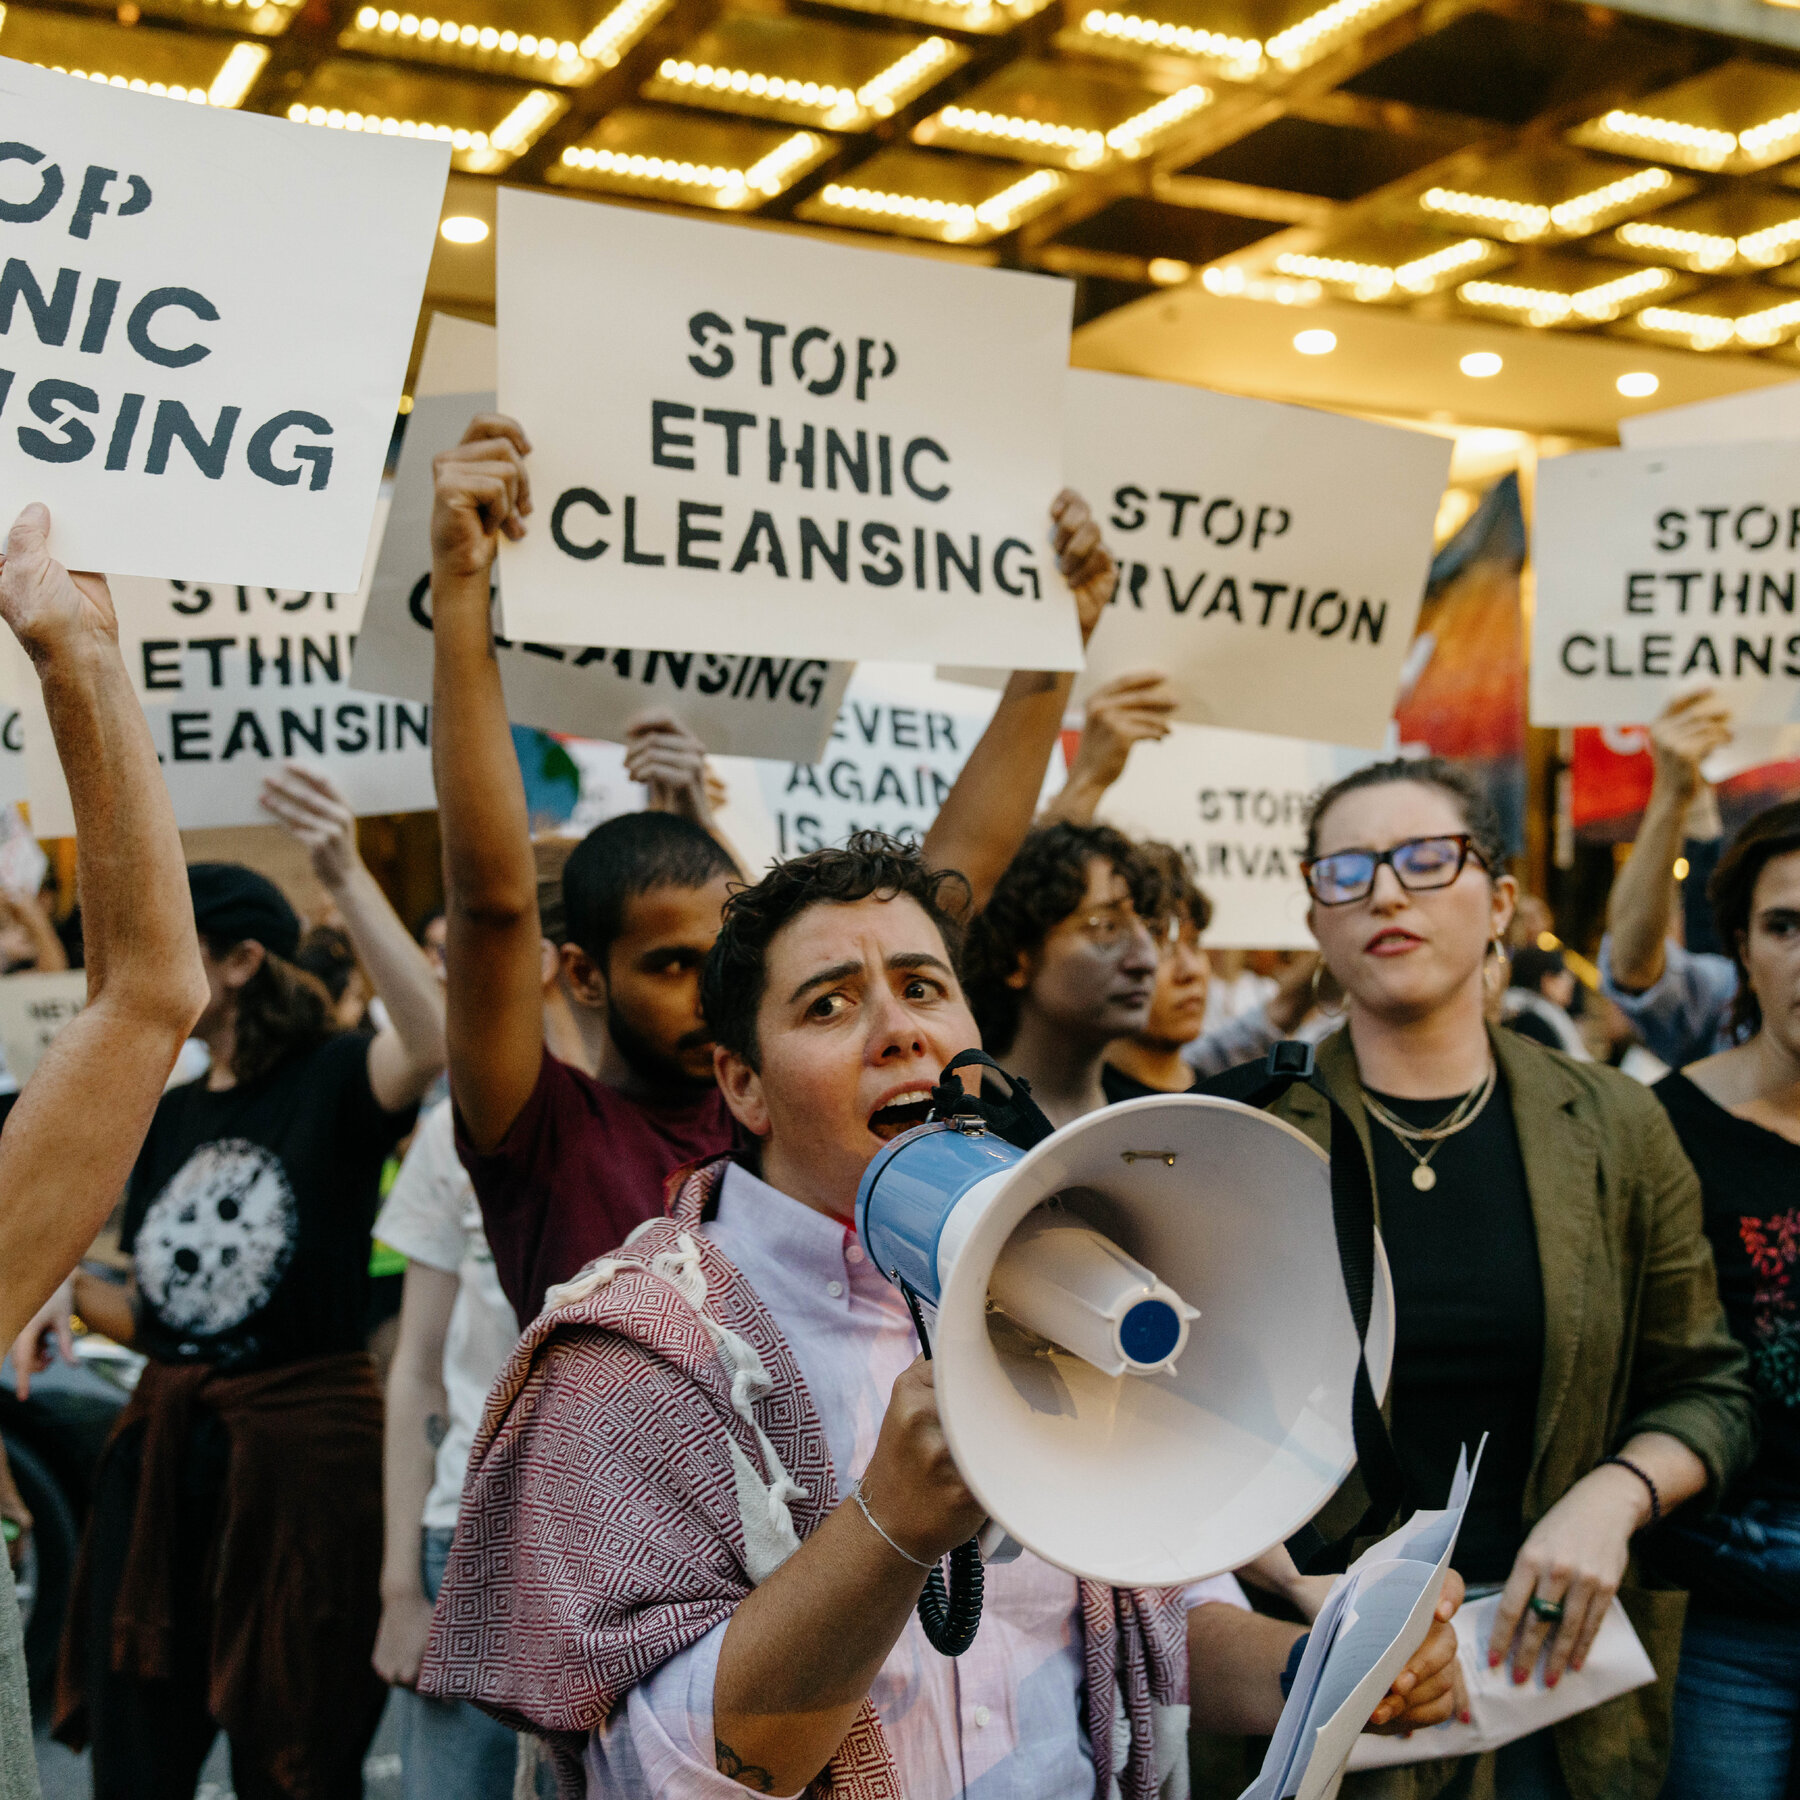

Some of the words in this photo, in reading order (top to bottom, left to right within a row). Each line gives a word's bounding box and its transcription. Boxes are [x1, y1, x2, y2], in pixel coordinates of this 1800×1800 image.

[687, 310, 897, 401] STOP
[651, 399, 952, 503] ETHNIC
[550, 487, 1043, 601] CLEANSING
[1109, 485, 1292, 551] STOP
[1656, 504, 1800, 553] STO
[157, 704, 428, 765] EANSIN
[776, 810, 823, 855] IS
